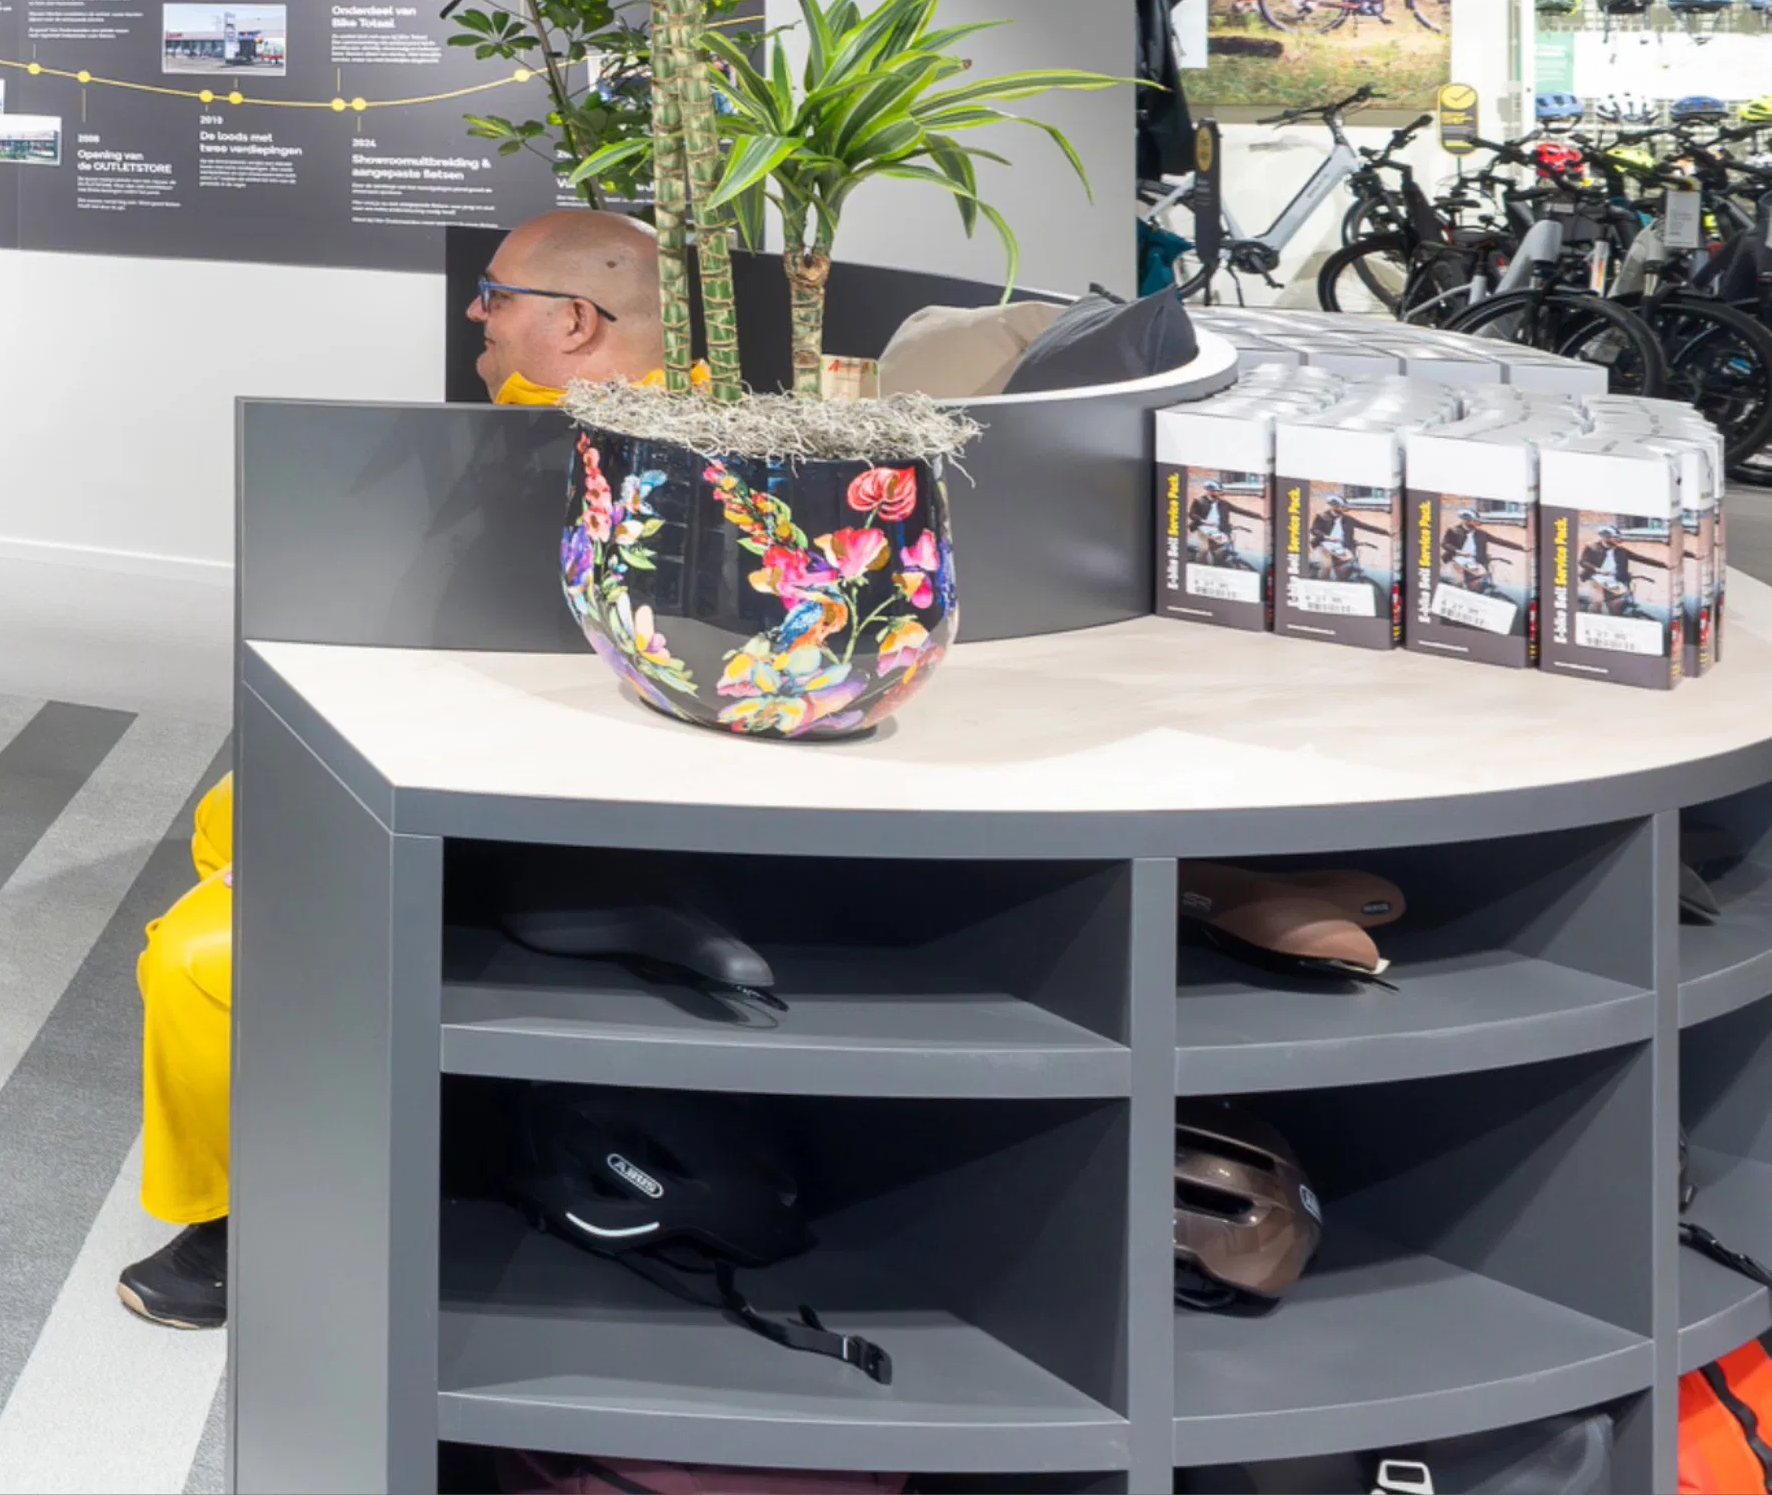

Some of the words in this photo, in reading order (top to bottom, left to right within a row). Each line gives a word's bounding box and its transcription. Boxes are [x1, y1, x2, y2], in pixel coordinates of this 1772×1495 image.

[395, 7, 417, 17] van
[199, 130, 215, 141] De
[77, 149, 122, 161] Opening
[123, 152, 145, 161] van
[77, 161, 92, 171] de
[93, 161, 173, 174] OUTLETSTORE
[1167, 500, 1179, 537] Service
[1287, 515, 1301, 552] Service
[1418, 528, 1431, 567] Service
[1553, 545, 1567, 586] Service
[611, 1158, 660, 1195] ABUS
